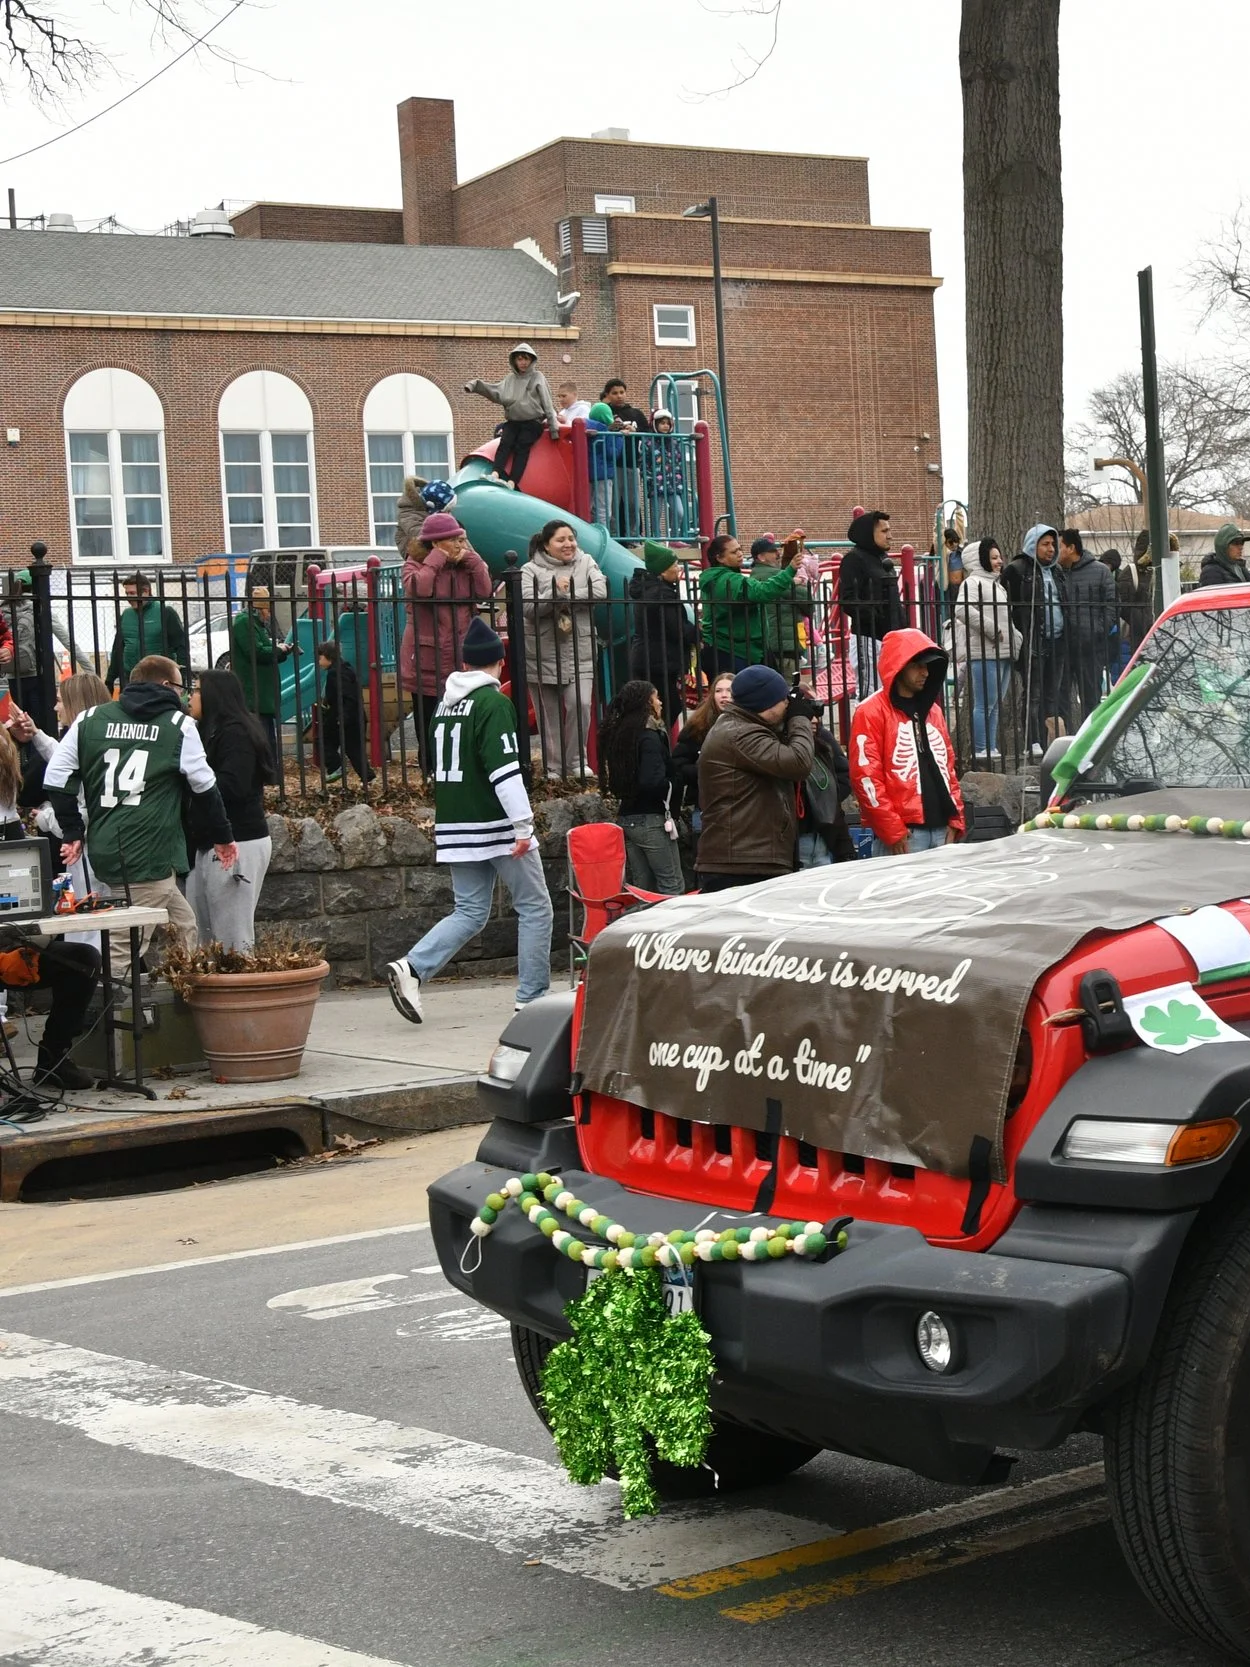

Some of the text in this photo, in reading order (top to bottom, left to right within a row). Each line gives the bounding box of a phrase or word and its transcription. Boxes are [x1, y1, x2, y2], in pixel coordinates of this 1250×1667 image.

[105, 722, 160, 742] DARNOLD
[434, 722, 463, 782] 11
[100, 748, 149, 808] 14
[626, 931, 972, 1005] "Where kindness is served
[648, 1032, 872, 1093] one cup at a time"
